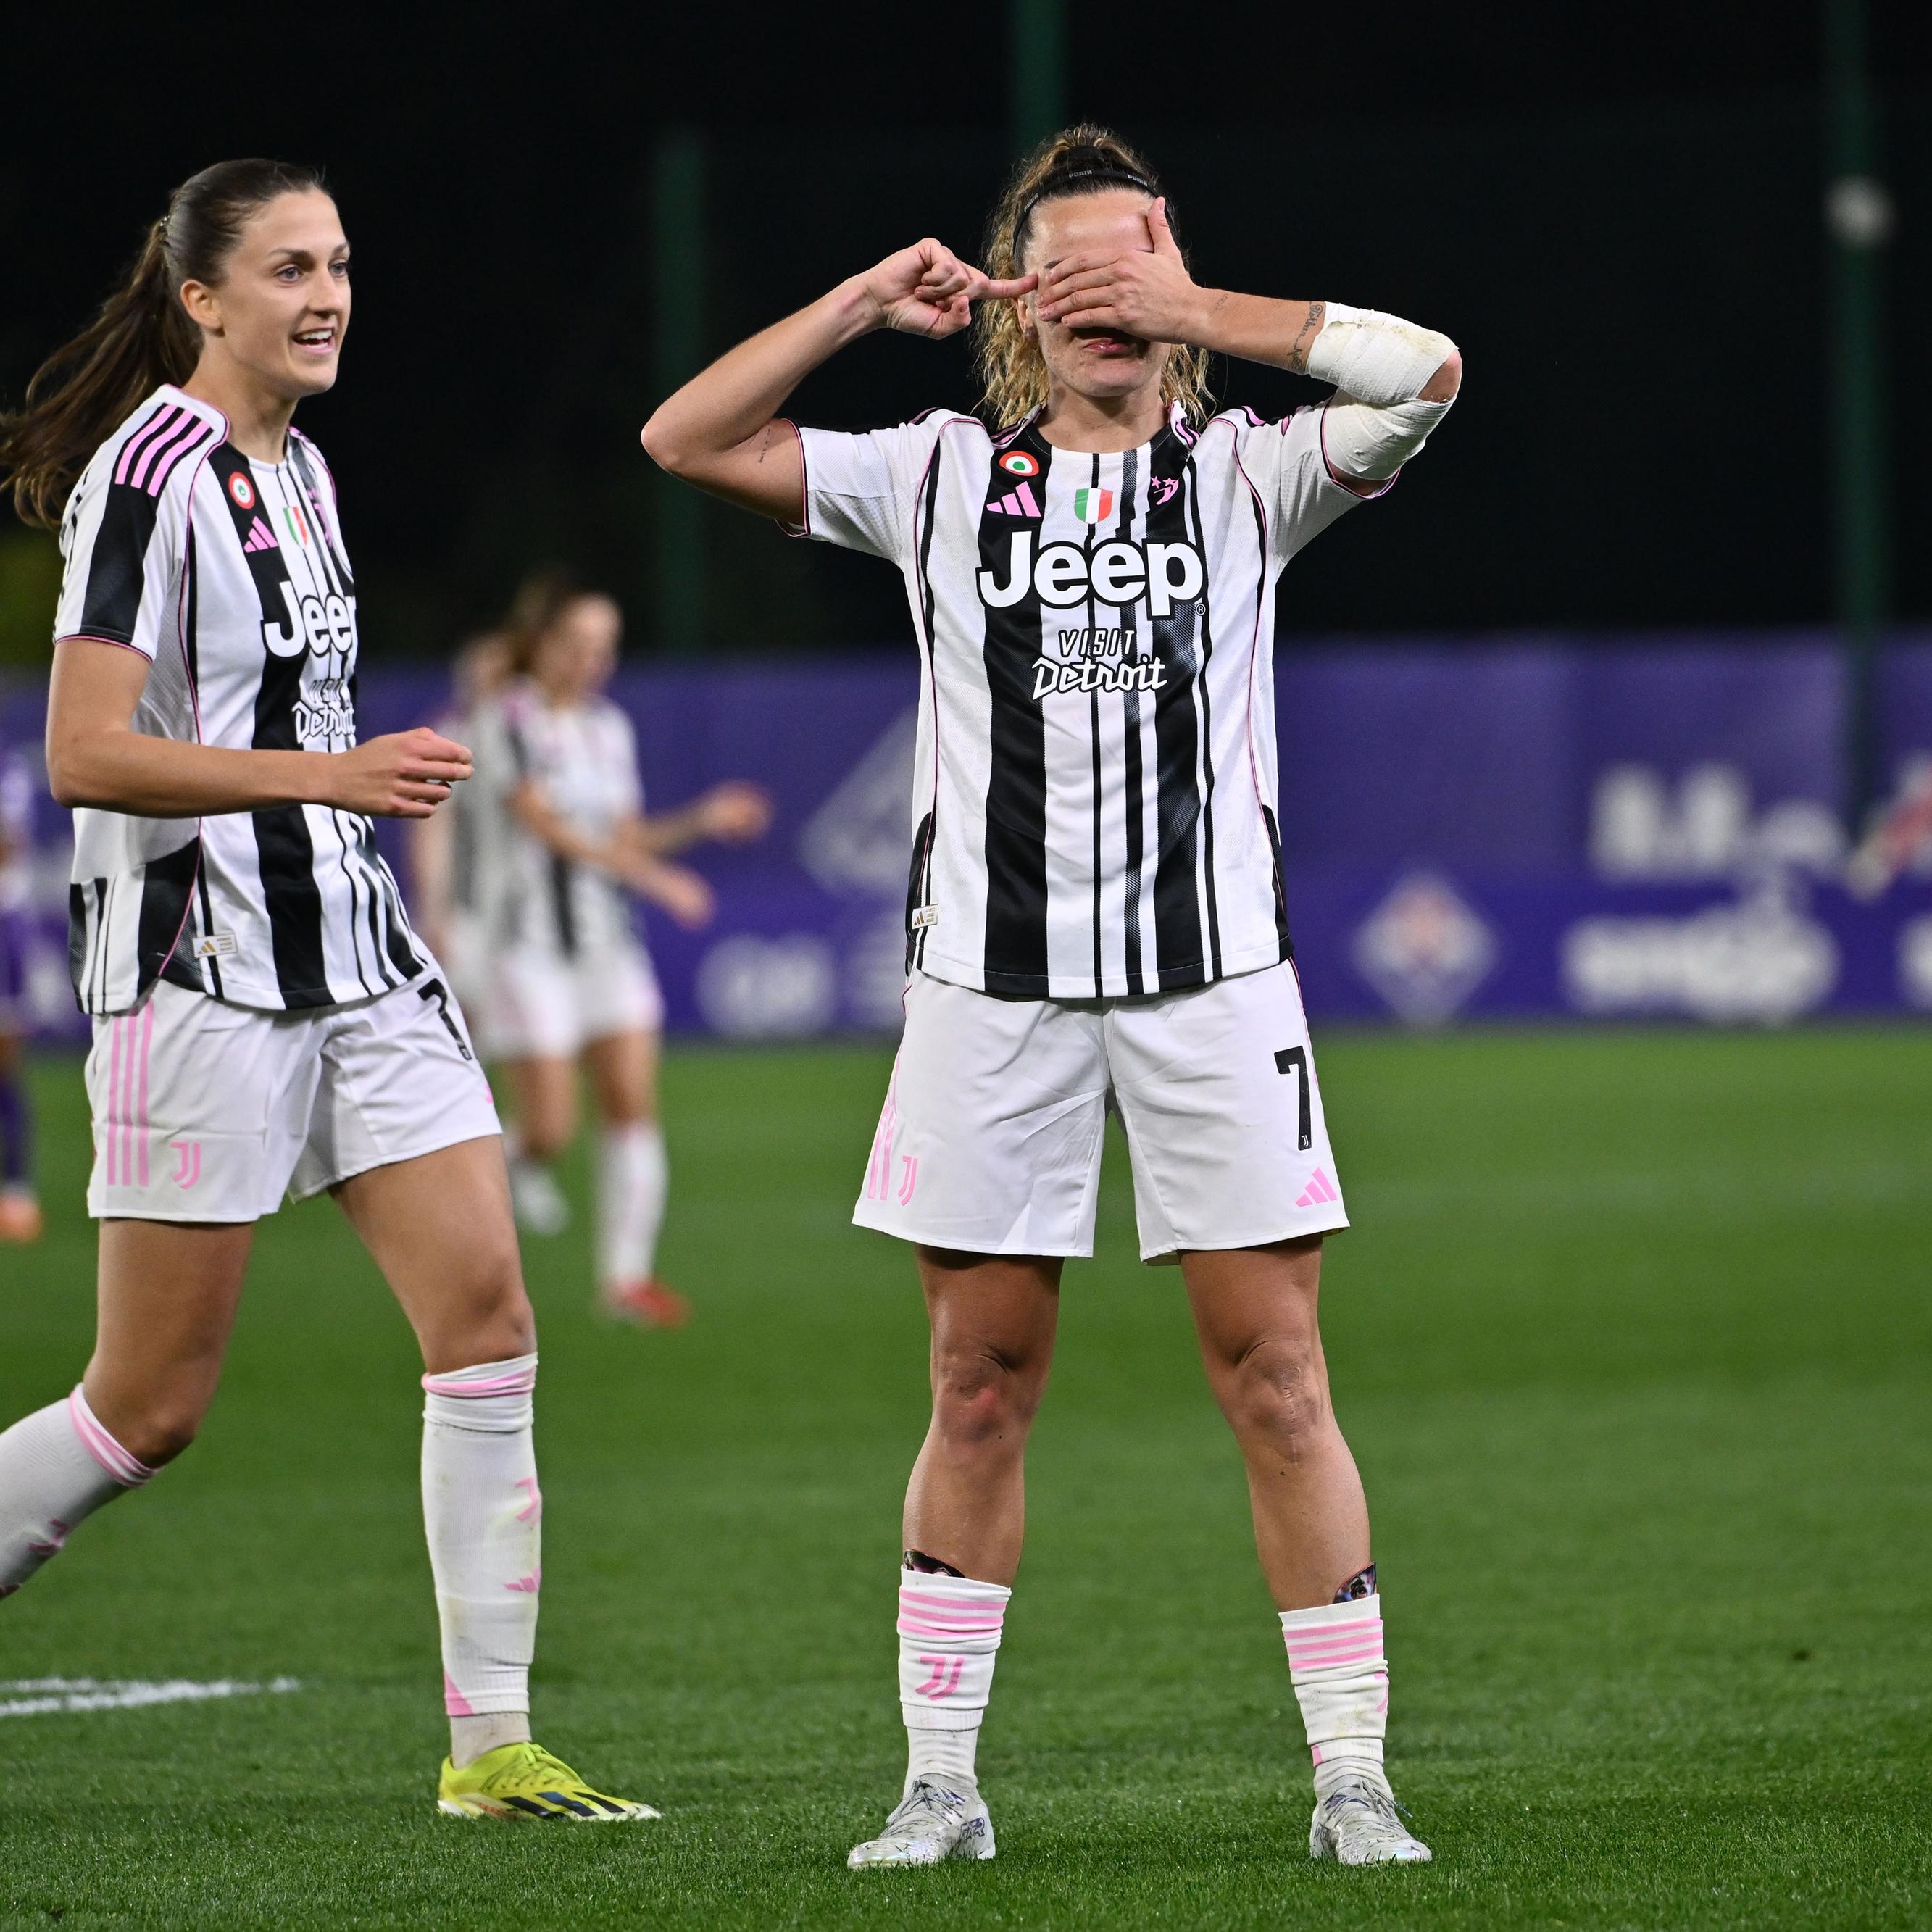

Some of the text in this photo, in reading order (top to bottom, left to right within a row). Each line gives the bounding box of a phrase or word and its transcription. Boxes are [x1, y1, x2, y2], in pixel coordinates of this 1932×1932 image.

[978, 530, 1204, 617] Jeep
[1059, 628, 1135, 657] VISIT
[1031, 655, 1168, 701] Detroit
[1273, 1045, 1312, 1151] 7
